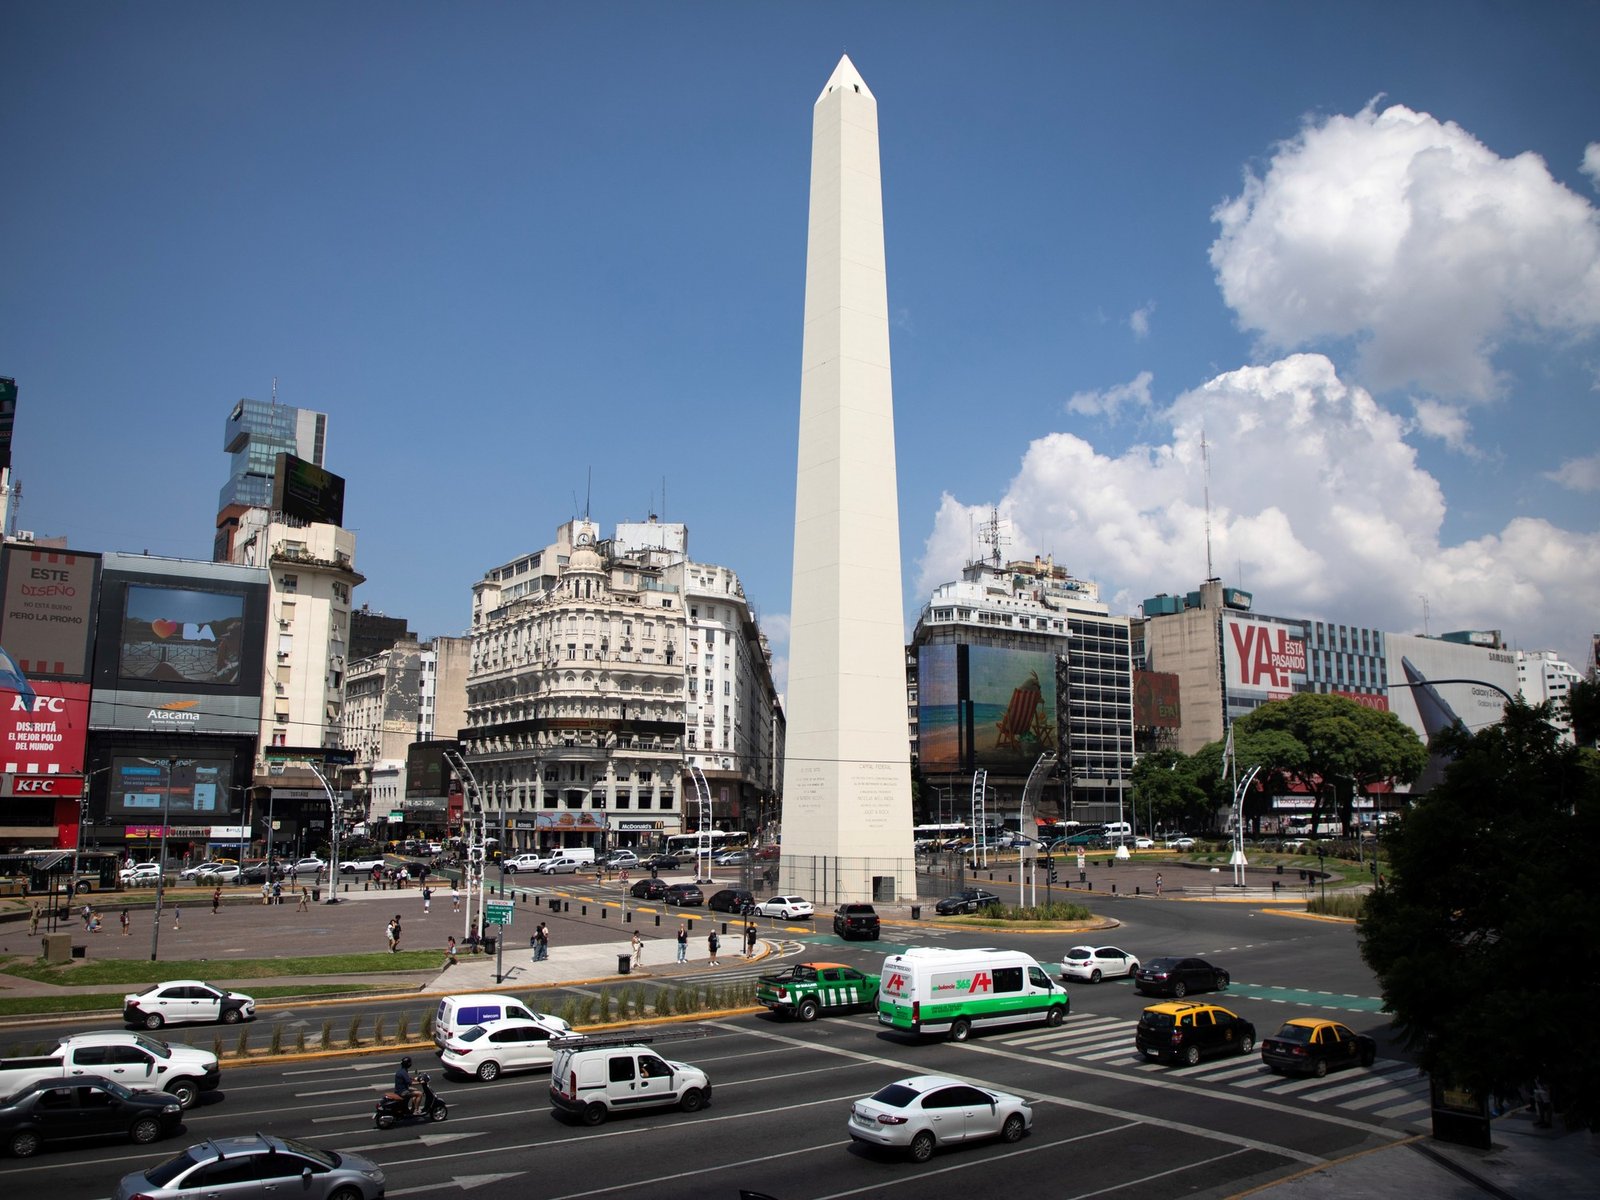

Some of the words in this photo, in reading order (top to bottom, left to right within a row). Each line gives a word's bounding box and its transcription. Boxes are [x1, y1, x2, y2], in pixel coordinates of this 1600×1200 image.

[31, 568, 69, 582] ESTE
[21, 583, 76, 597] DISEÑO
[9, 611, 34, 620] PERO
[50, 615, 82, 624] PROMO
[182, 623, 216, 642] BA
[1229, 622, 1289, 687] YA!
[1285, 641, 1304, 656] ESTÁ
[1271, 654, 1305, 670] PASANDO
[1488, 653, 1514, 664] SAMSUNG
[1472, 688, 1489, 698] Galaxy
[10, 695, 65, 712] KFC
[147, 709, 200, 721] Atacama
[8, 732, 16, 741] EL
[17, 733, 40, 741] MEJOR
[41, 733, 62, 742] POLLO
[15, 742, 27, 750] DEL
[29, 742, 54, 751] MUNDO
[16, 780, 54, 791] KFC
[955, 979, 971, 989] 365
